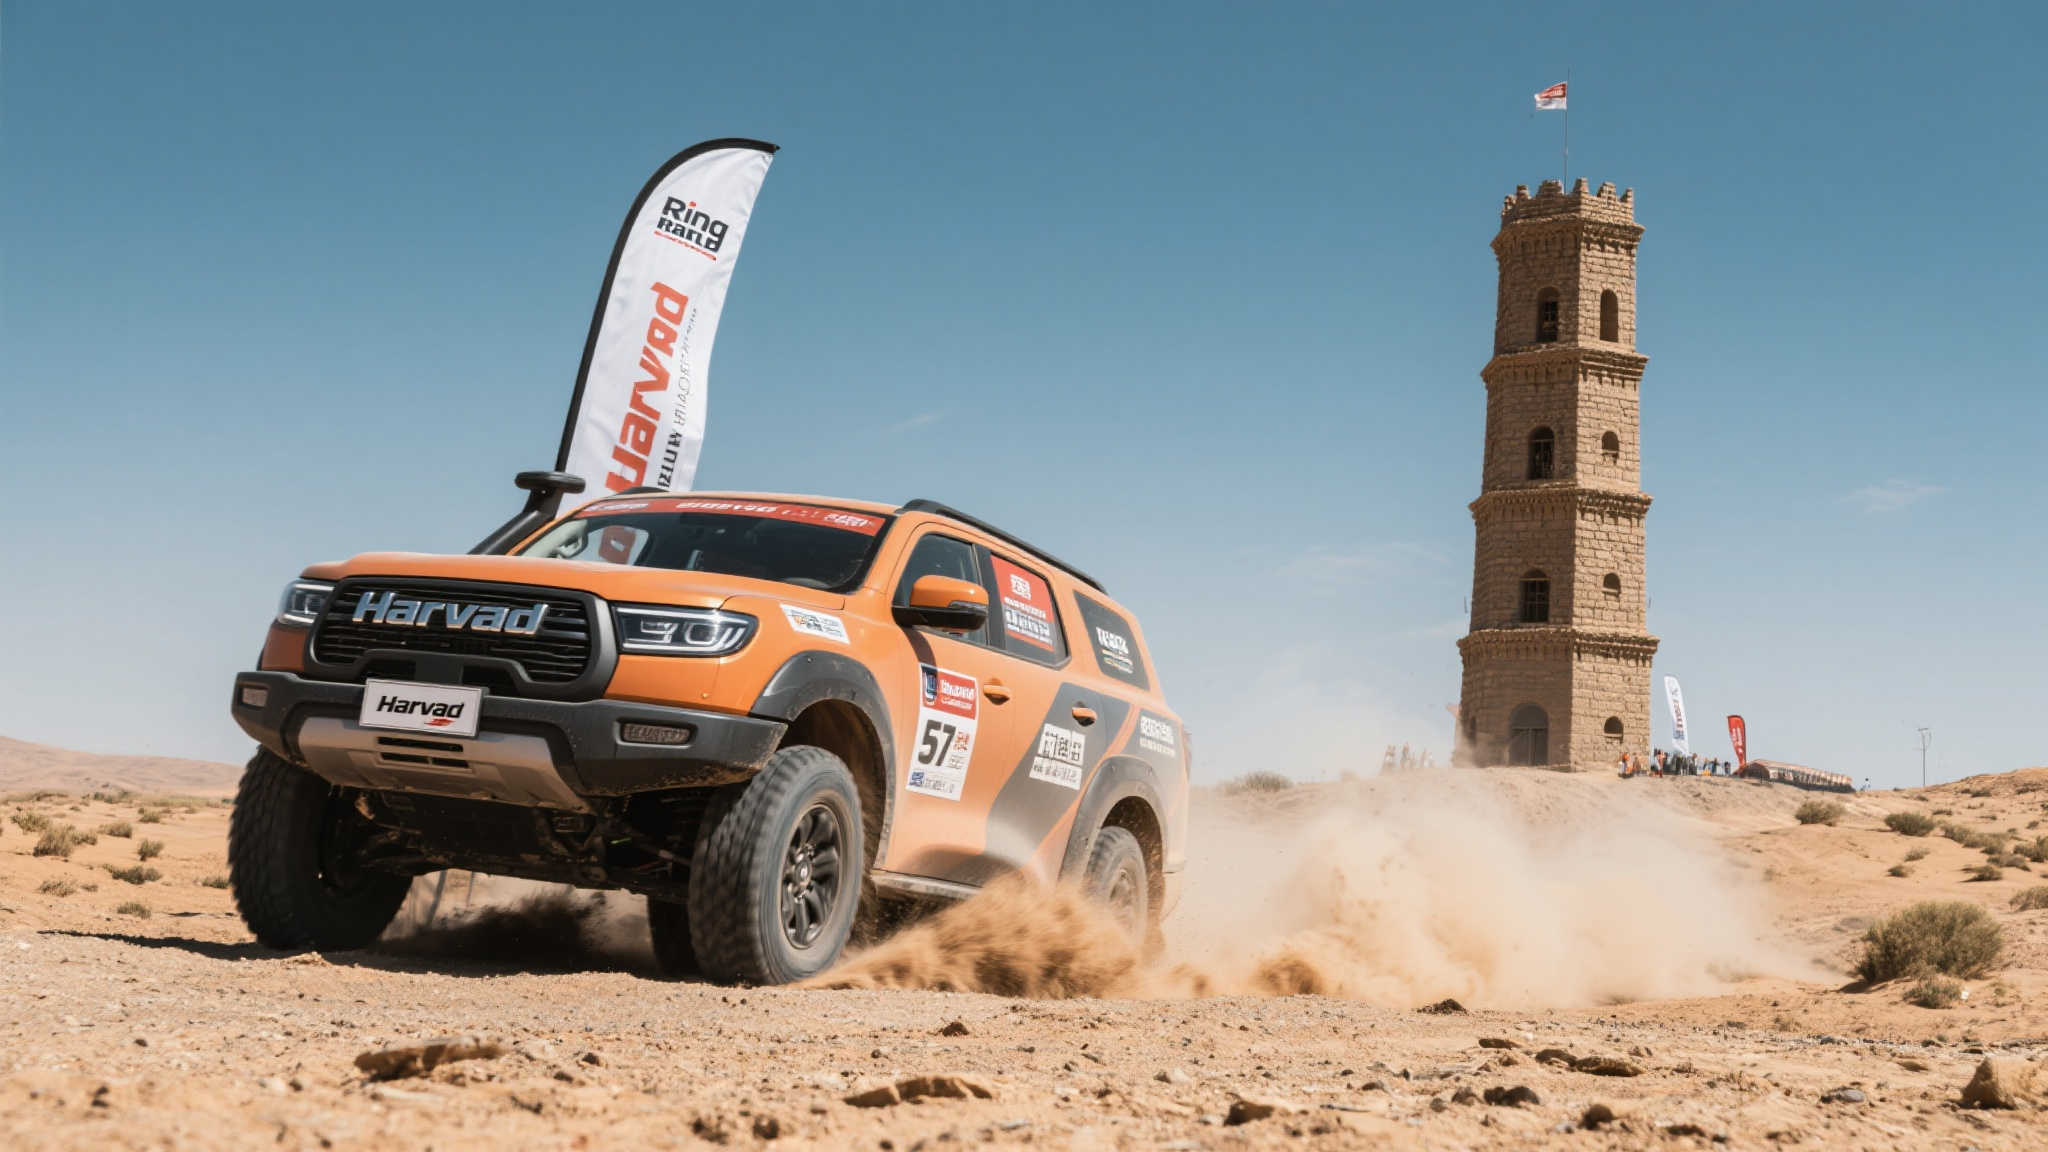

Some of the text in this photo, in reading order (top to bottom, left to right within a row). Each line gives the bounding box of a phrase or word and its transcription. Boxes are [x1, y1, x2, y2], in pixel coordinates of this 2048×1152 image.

[662, 196, 729, 242] Ring
[351, 591, 549, 636] Harvad
[375, 695, 465, 719] Harvad
[917, 718, 957, 767] 57
